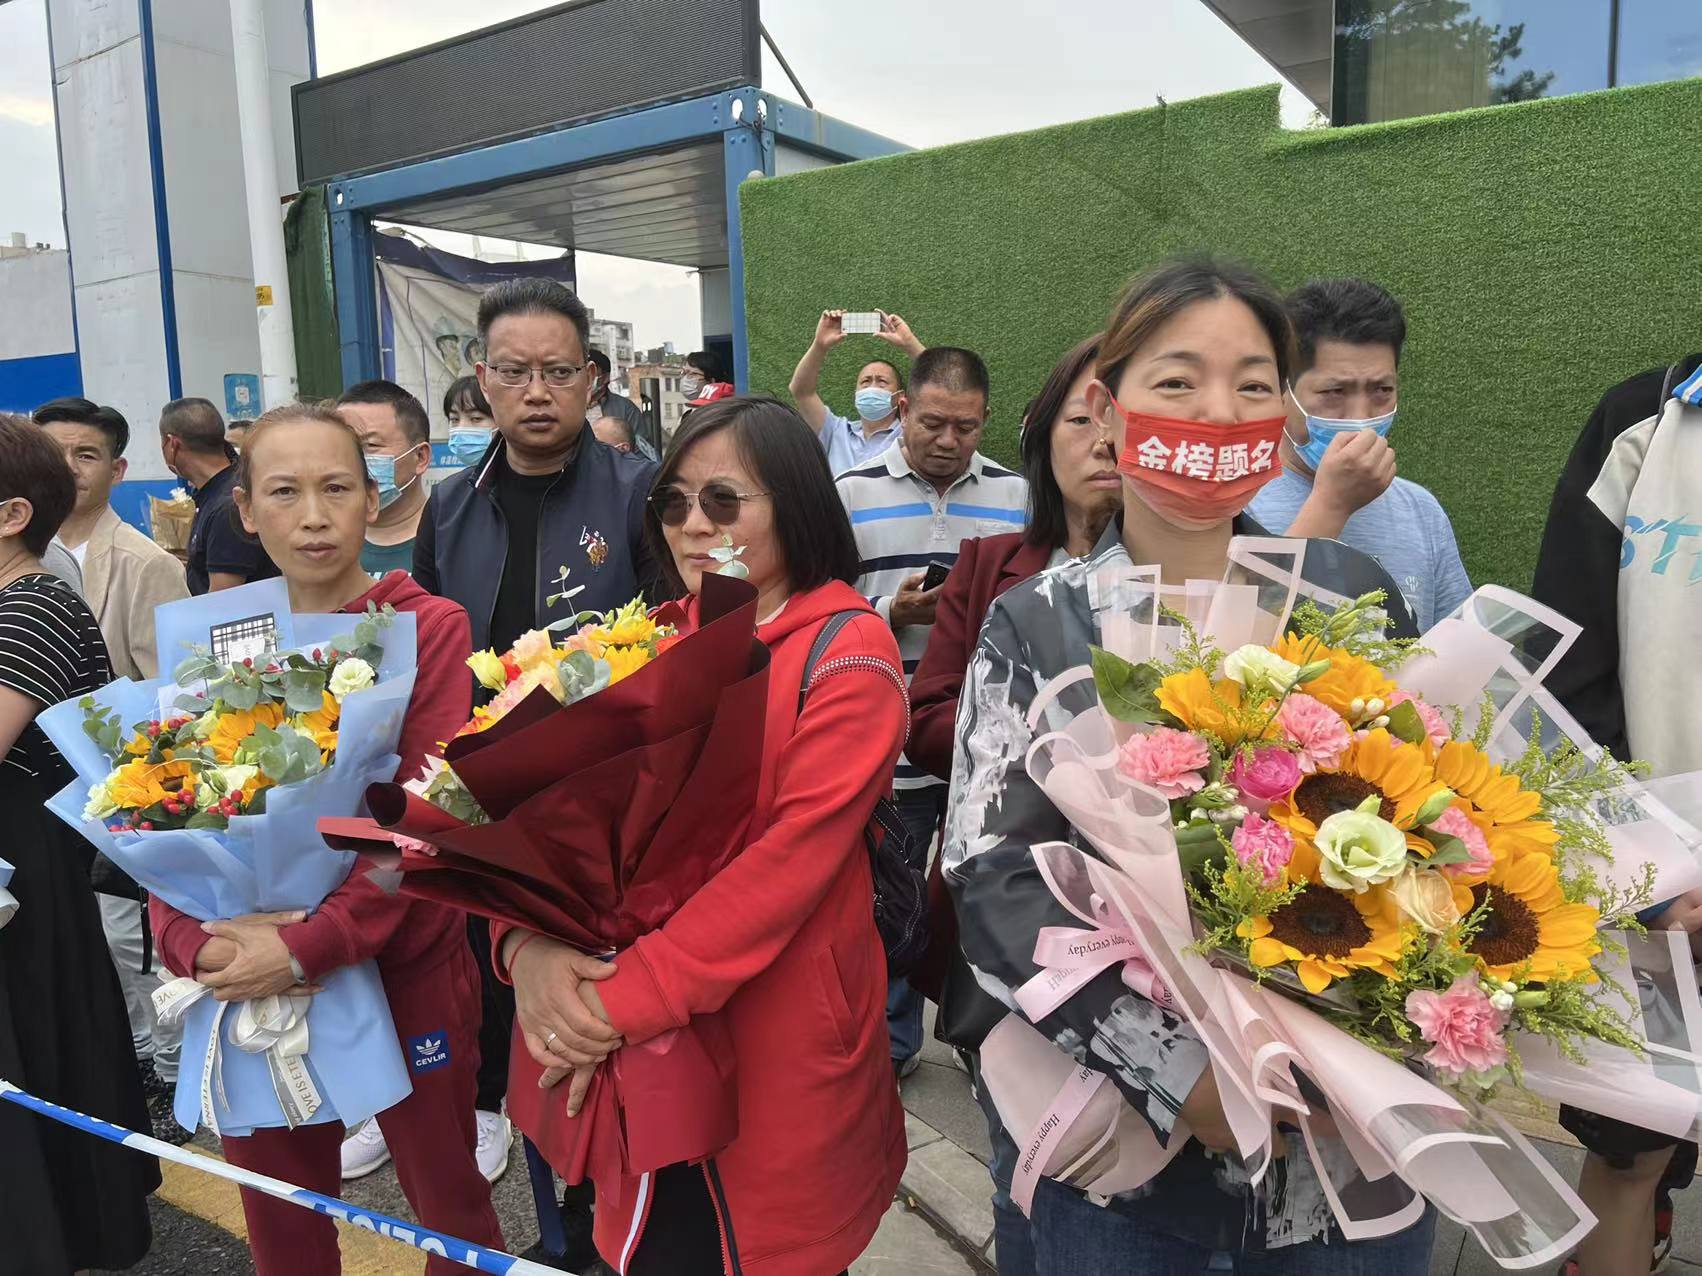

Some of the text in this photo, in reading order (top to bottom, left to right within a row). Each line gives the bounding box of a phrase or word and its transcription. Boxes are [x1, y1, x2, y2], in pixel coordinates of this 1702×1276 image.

[1137, 435, 1275, 482] 金榜题名
[1068, 938, 1110, 957] everyday
[416, 1053, 446, 1066] CEVLIR
[1021, 1113, 1060, 1176] Happy everyday
